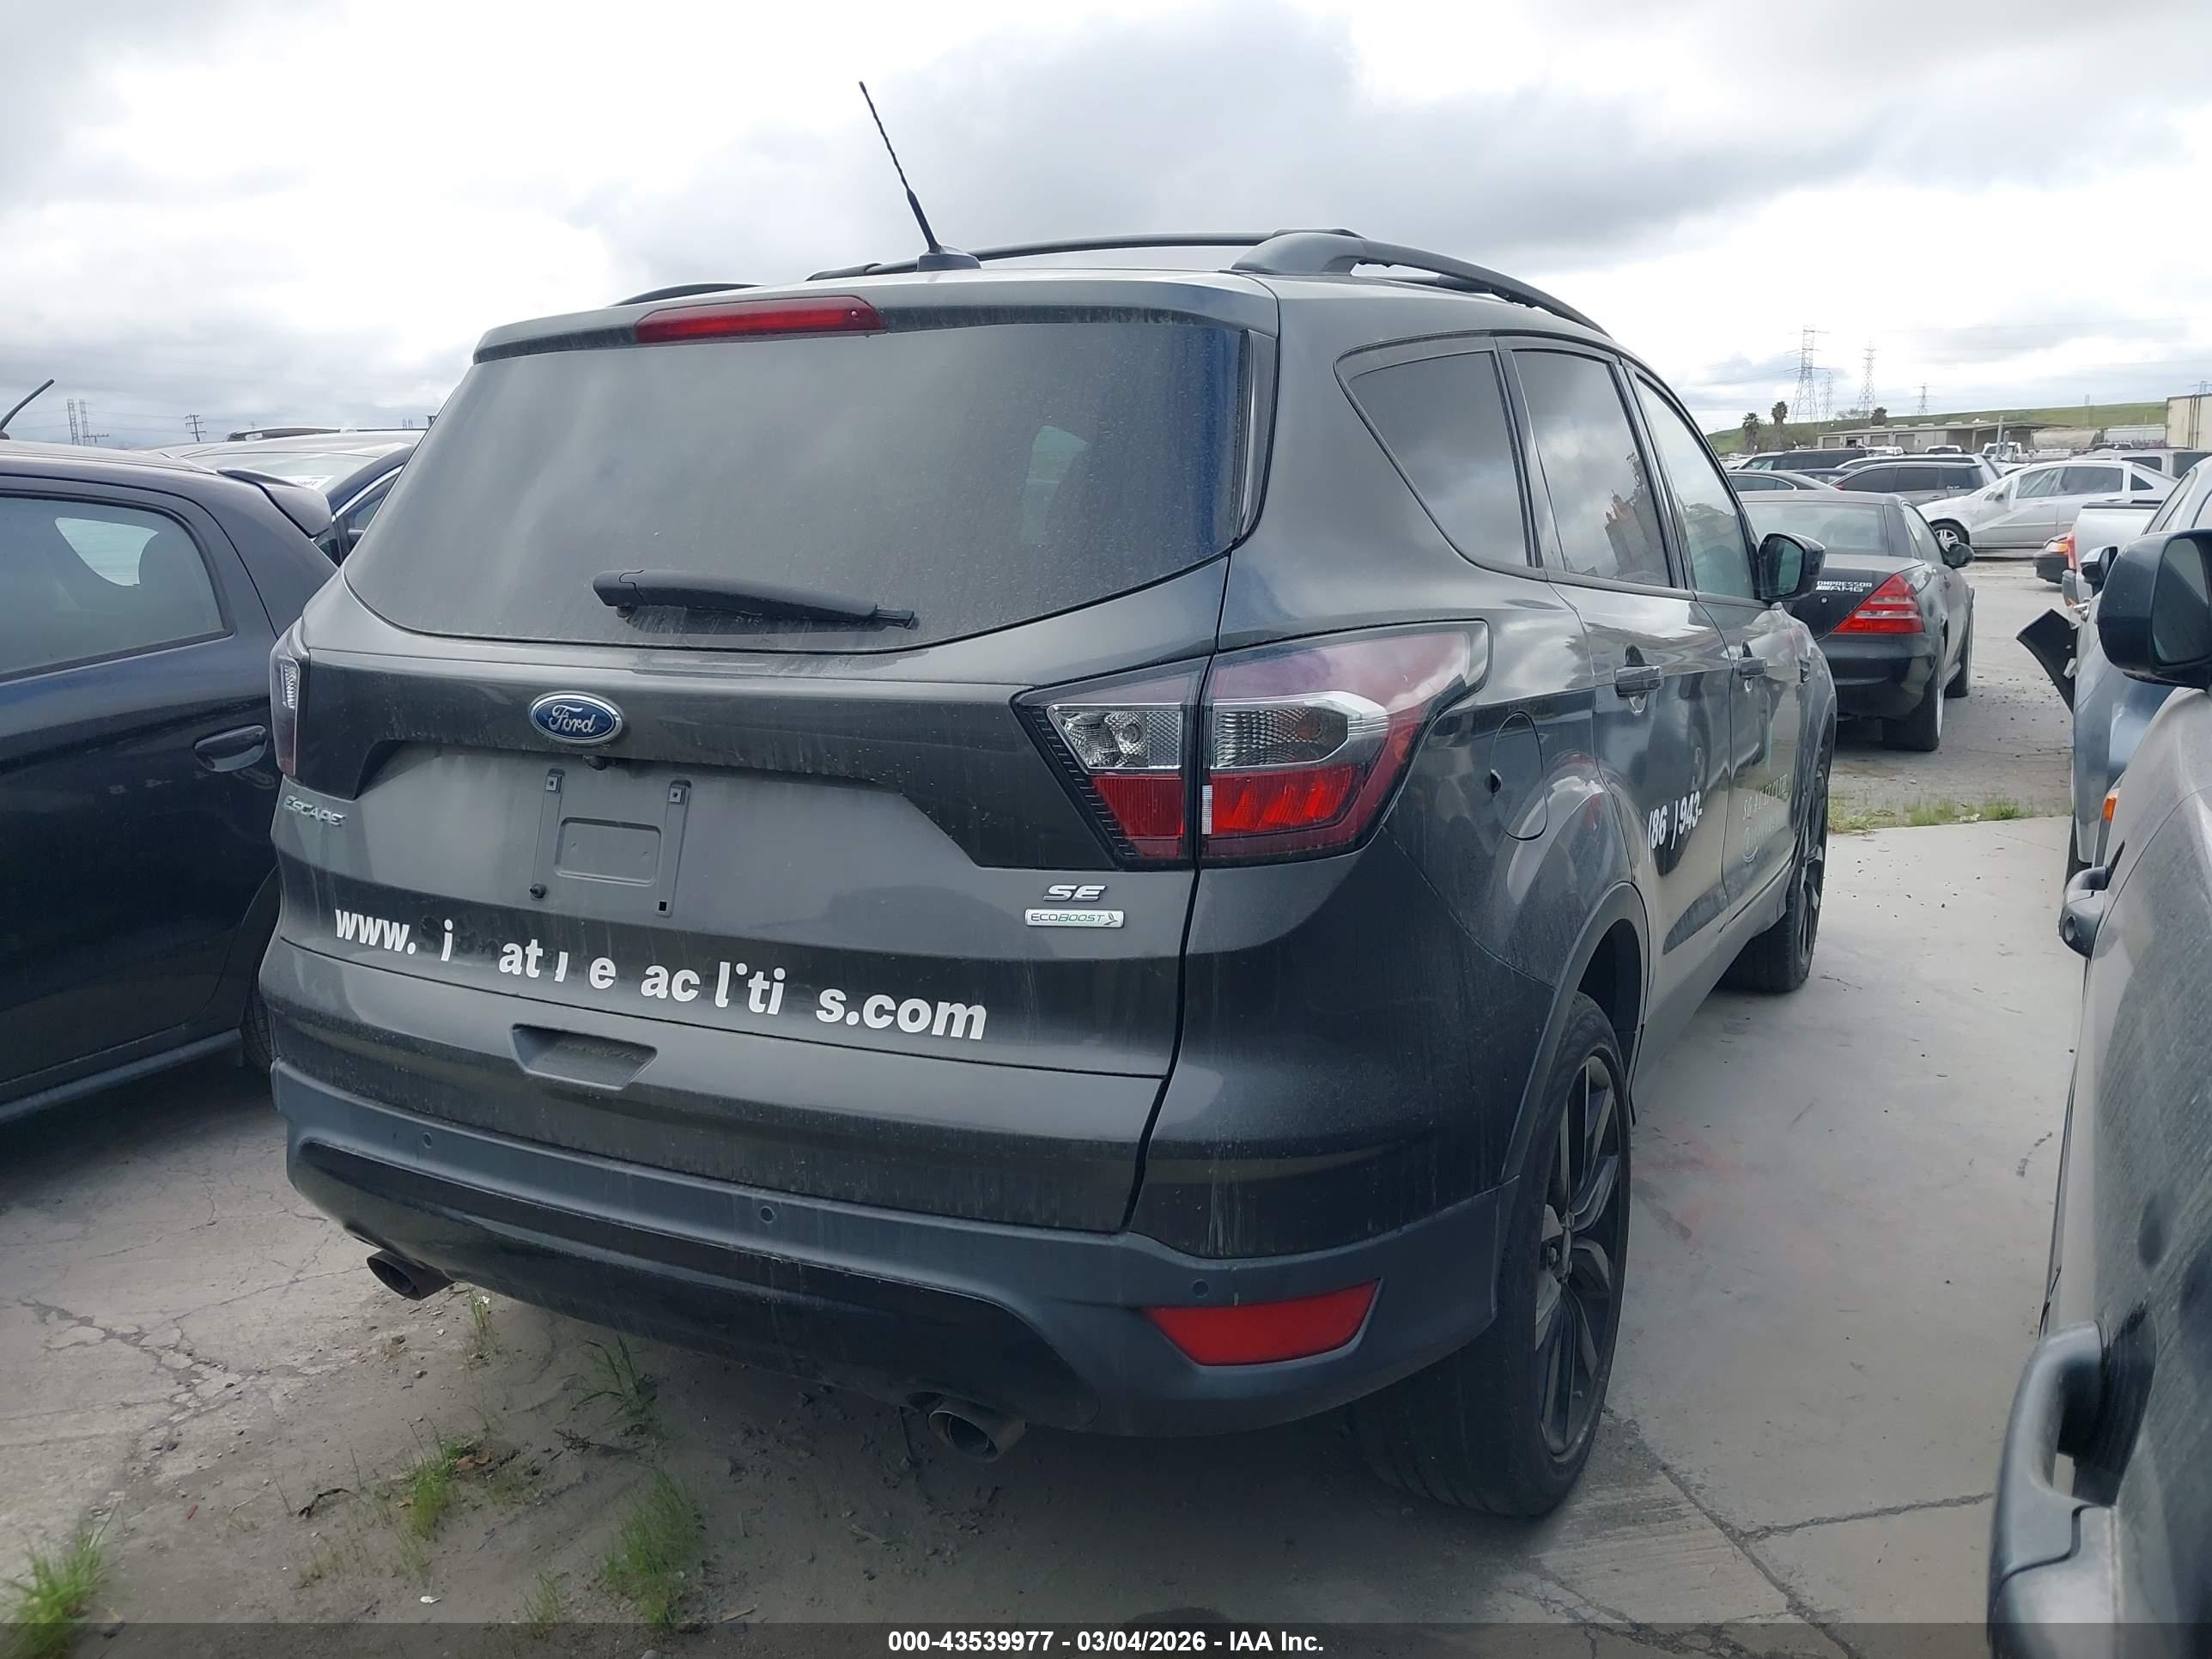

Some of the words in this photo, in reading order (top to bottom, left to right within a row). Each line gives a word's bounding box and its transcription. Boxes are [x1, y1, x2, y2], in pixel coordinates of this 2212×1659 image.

[1816, 580, 1873, 588] OMPRESSOR
[548, 704, 597, 733] Ford
[281, 794, 347, 826] ESCAPE
[1042, 884, 1108, 902] SE
[1030, 913, 1105, 923] ECOBOOST
